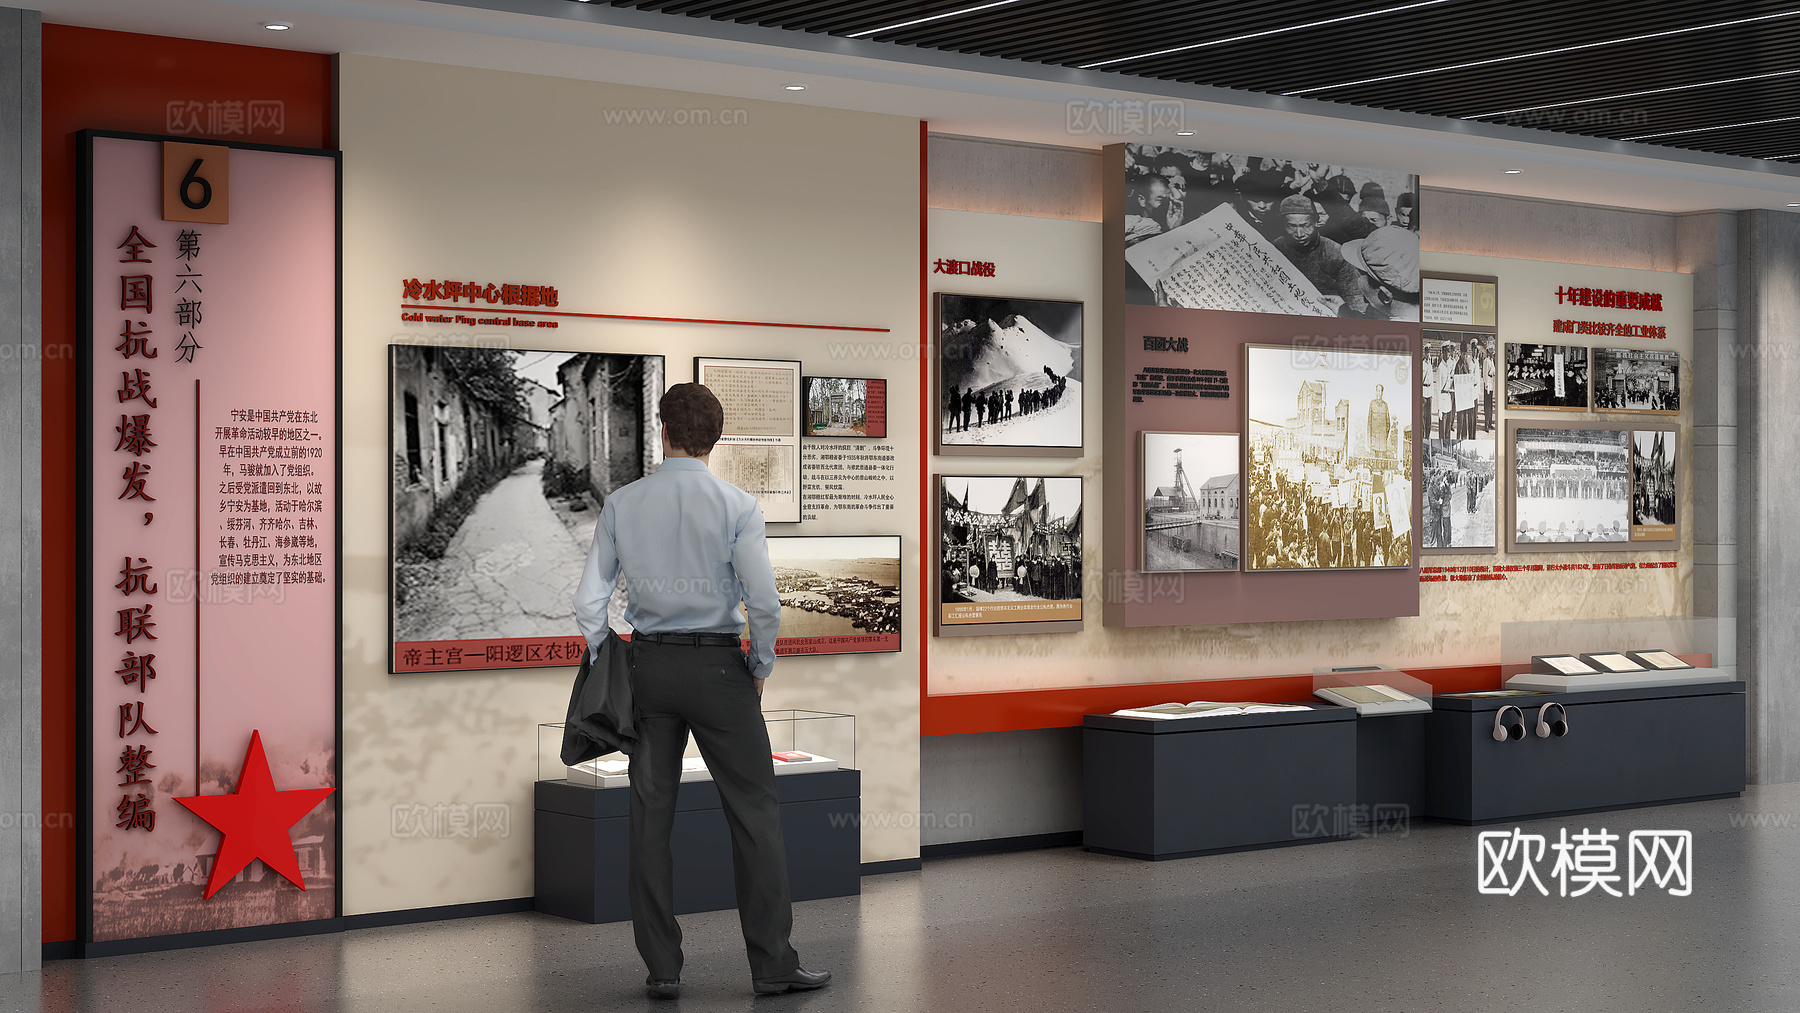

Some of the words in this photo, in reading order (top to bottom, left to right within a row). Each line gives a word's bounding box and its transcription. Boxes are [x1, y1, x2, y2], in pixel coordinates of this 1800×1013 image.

[180, 159, 212, 209] 6
[933, 258, 997, 277] 大渡口战役
[174, 229, 203, 363] 第六部分
[402, 278, 559, 307] 冷水坪中心根据地
[1555, 285, 1663, 311] 十年建设的重要成就
[401, 312, 424, 322] Cold
[425, 314, 453, 323] water
[456, 315, 476, 326] Ping
[478, 317, 511, 326] central
[513, 318, 536, 327] base
[1553, 319, 1667, 339] 建成门类比较齐全的工业体系
[1143, 335, 1189, 352] 百团大战
[231, 409, 318, 423] 宁安是中国共产党在东北
[215, 427, 322, 441] 开展革命活动较早的地区之一。
[219, 445, 322, 459] 早在中国共产党成立前的1920
